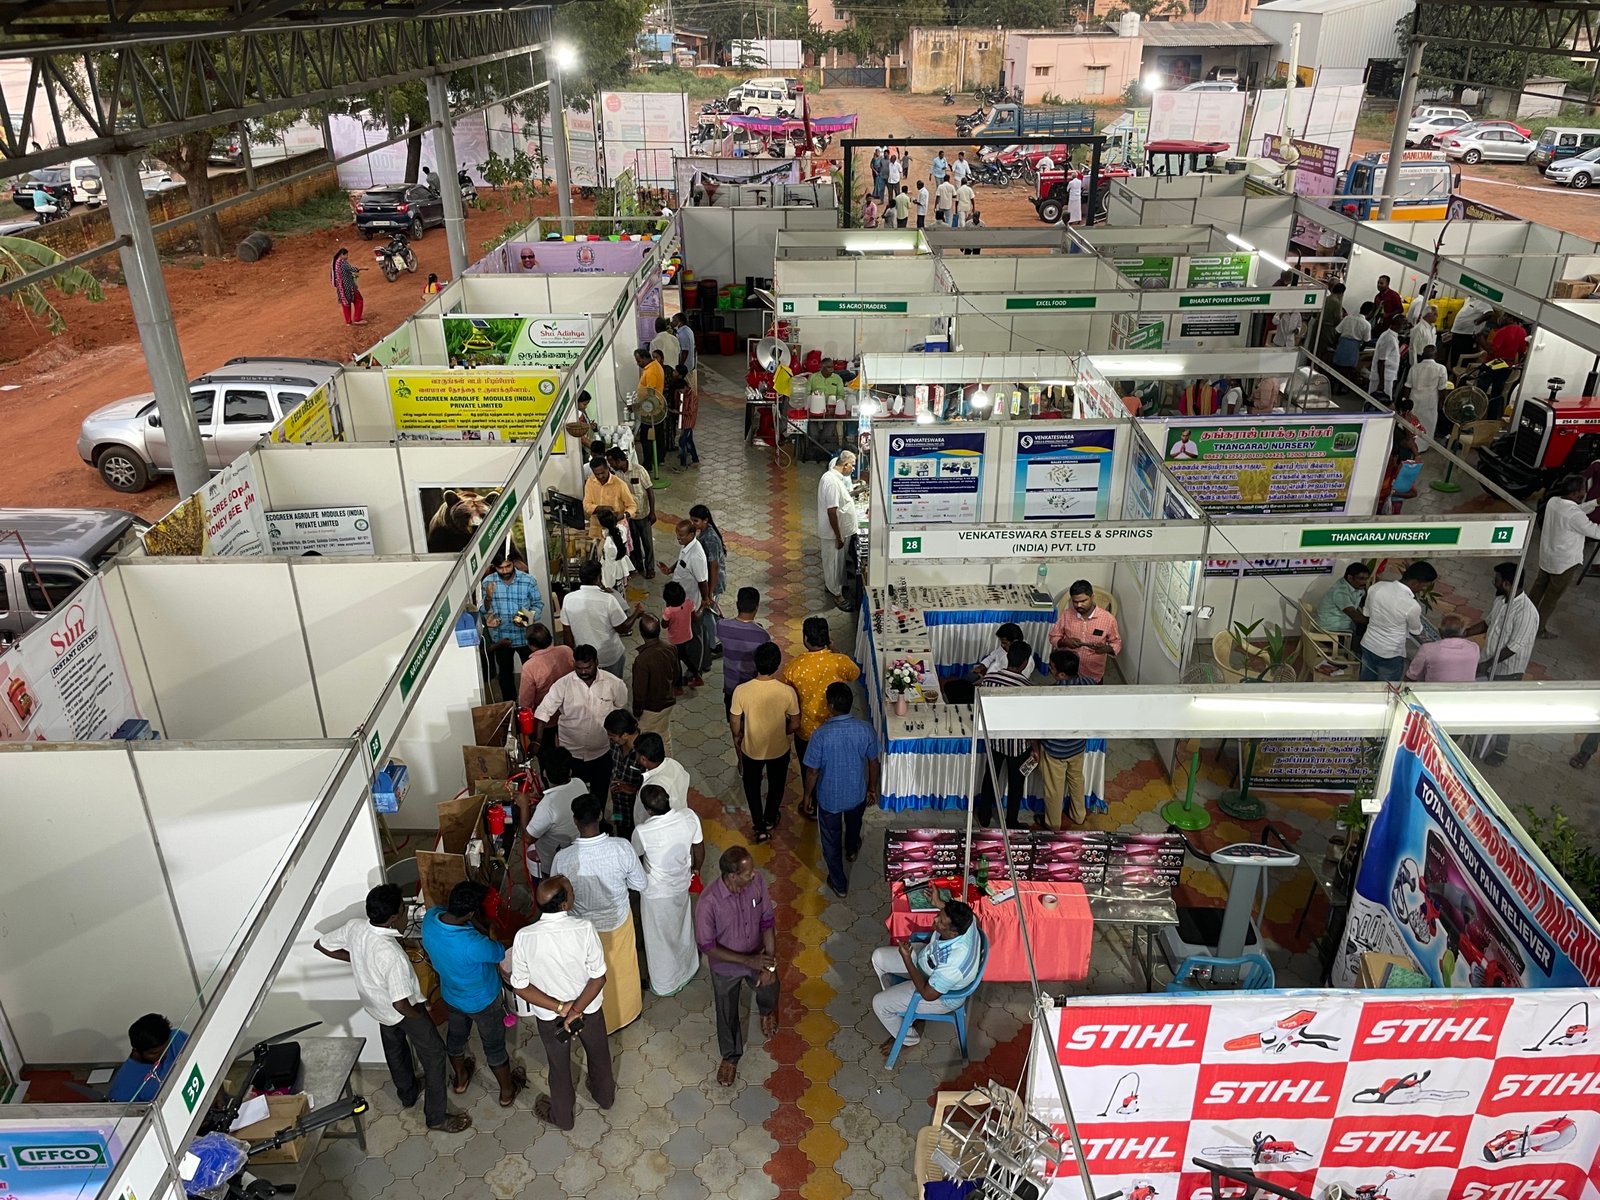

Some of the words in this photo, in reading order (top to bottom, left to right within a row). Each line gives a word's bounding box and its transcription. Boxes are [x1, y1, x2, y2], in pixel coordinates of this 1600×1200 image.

[1200, 428, 1259, 442] தங்கராஜ்
[1260, 427, 1296, 440] பாக்கு
[1298, 426, 1334, 439] நர்சரி
[1214, 442, 1269, 451] THANGARAJ
[1271, 441, 1316, 450] NURSERY
[212, 498, 228, 516] SREE
[265, 513, 293, 522] ECOGREEN
[294, 511, 319, 520] AGROLIFE
[321, 510, 346, 518] MODULES
[347, 509, 365, 517] (INDIA)
[207, 515, 228, 540] HONEY
[228, 503, 243, 520] BEE
[295, 521, 317, 529] PRIVATE
[958, 530, 1048, 541] VENKATESWARA
[1050, 529, 1092, 540] STEELS
[1094, 530, 1101, 539] &
[1105, 529, 1153, 539] SPRINGS
[1331, 532, 1386, 542] THANGARAJ
[1387, 531, 1430, 541] NURSERY
[1497, 531, 1508, 540] 12
[906, 541, 918, 550] 28
[1012, 543, 1048, 554] (INDIA)
[1051, 543, 1073, 553] PVT.
[1076, 542, 1096, 552] LTD
[50, 604, 86, 659] Sun
[410, 642, 428, 678] NATIONAL
[425, 614, 444, 651] ASSOCIATES
[53, 649, 77, 675] INSTANT
[370, 738, 380, 754] 38
[1421, 783, 1446, 823] TOTAL
[1445, 819, 1458, 842] ALL
[1459, 838, 1480, 875] BODY
[1480, 868, 1500, 906] PAIN
[1500, 897, 1551, 969] RELIEVER
[1066, 1022, 1196, 1050] STIHL
[1363, 1016, 1492, 1046] STIHL
[187, 1076, 201, 1102] 39
[1202, 1078, 1332, 1106] STIHL
[1491, 1071, 1600, 1101] STIHL
[1332, 1127, 1458, 1155] STIHL
[28, 1149, 91, 1161] IFFCO
